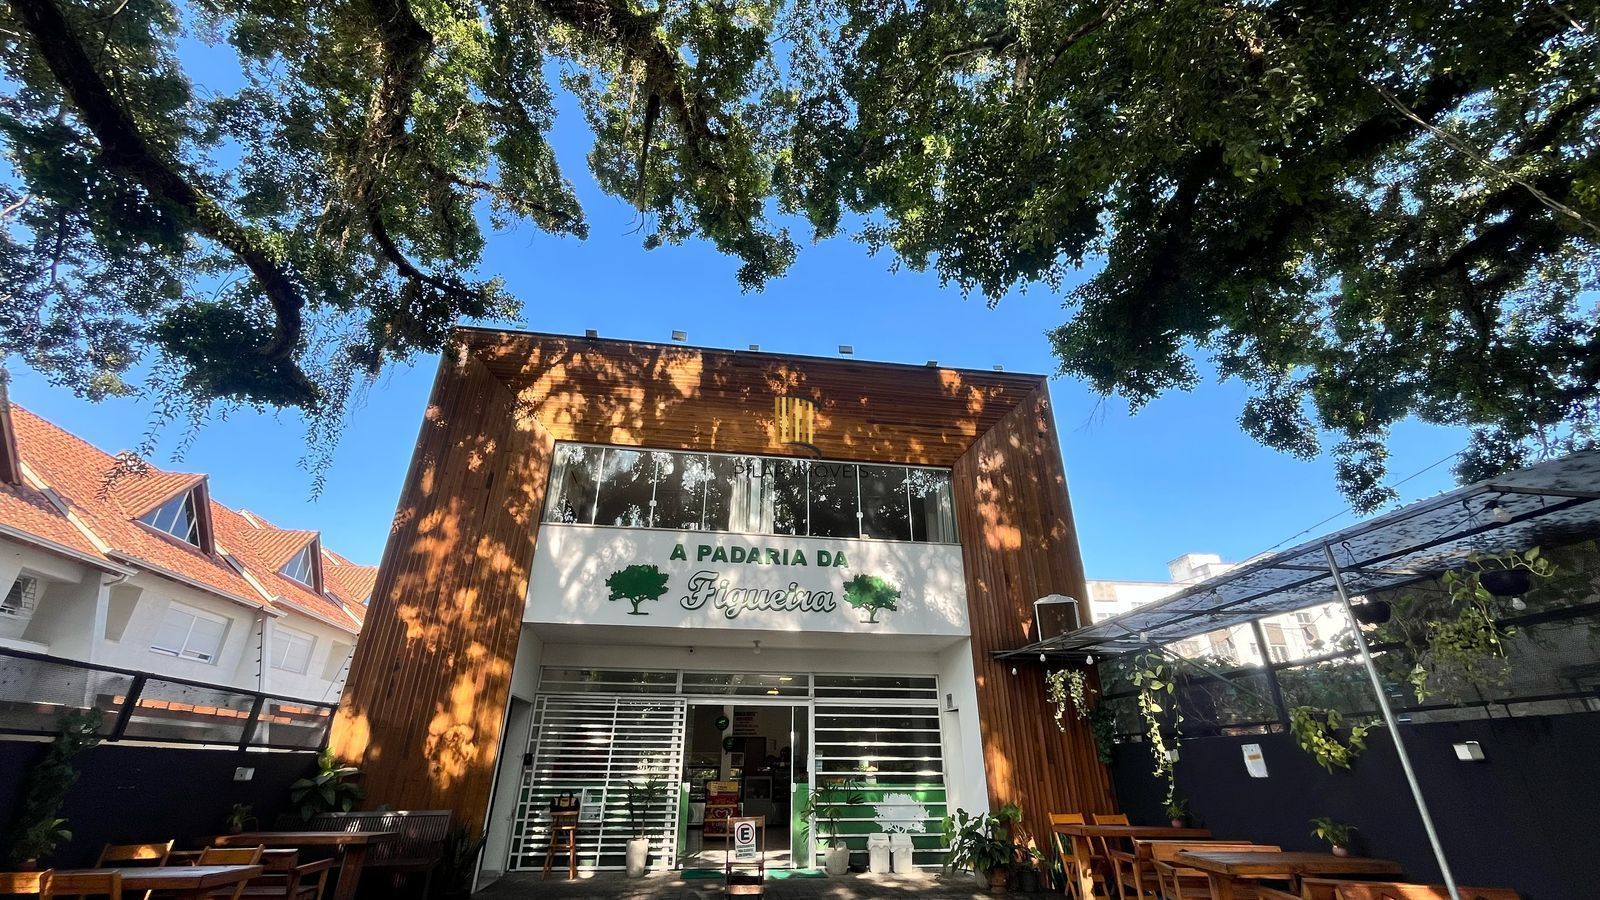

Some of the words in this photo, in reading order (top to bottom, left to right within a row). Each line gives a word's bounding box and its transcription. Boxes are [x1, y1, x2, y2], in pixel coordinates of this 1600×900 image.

[669, 543, 687, 561] A
[697, 544, 808, 567] PADARIA
[817, 550, 849, 569] DA
[679, 570, 837, 620] Figueira
[740, 827, 750, 840] E
